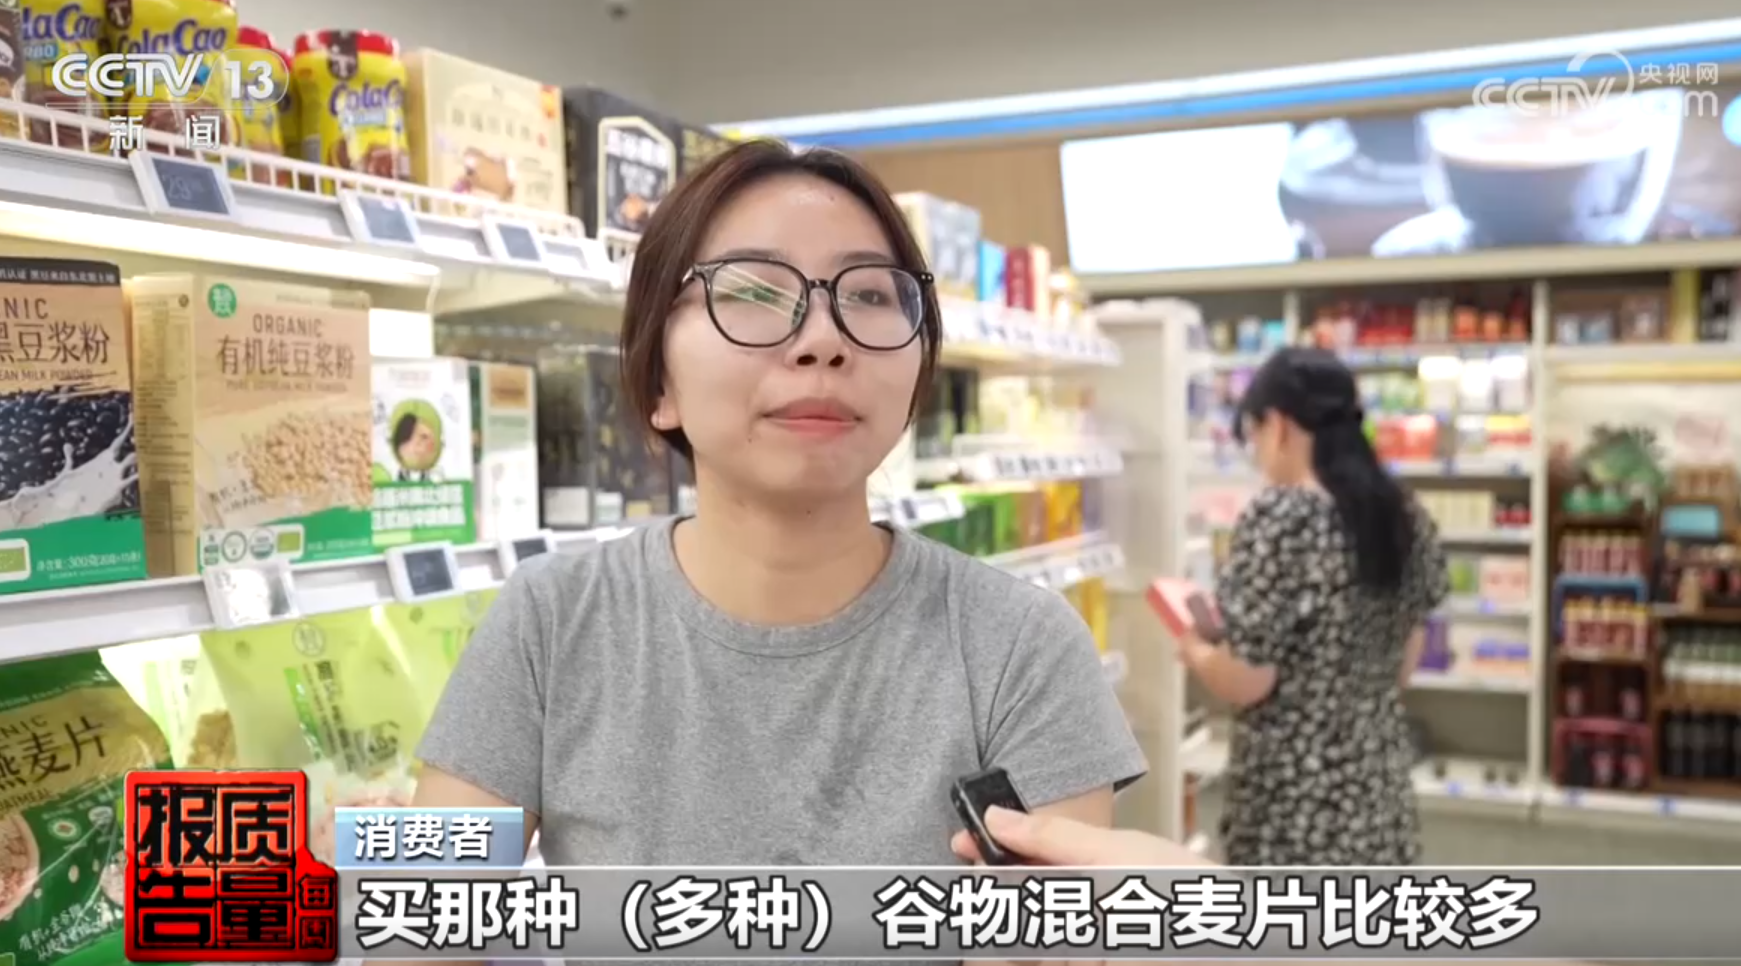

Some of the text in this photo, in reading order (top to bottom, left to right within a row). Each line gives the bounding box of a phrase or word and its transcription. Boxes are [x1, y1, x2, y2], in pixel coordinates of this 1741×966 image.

[253, 313, 325, 339] ORGANIC
[216, 334, 355, 380] 有机纯豆浆粉
